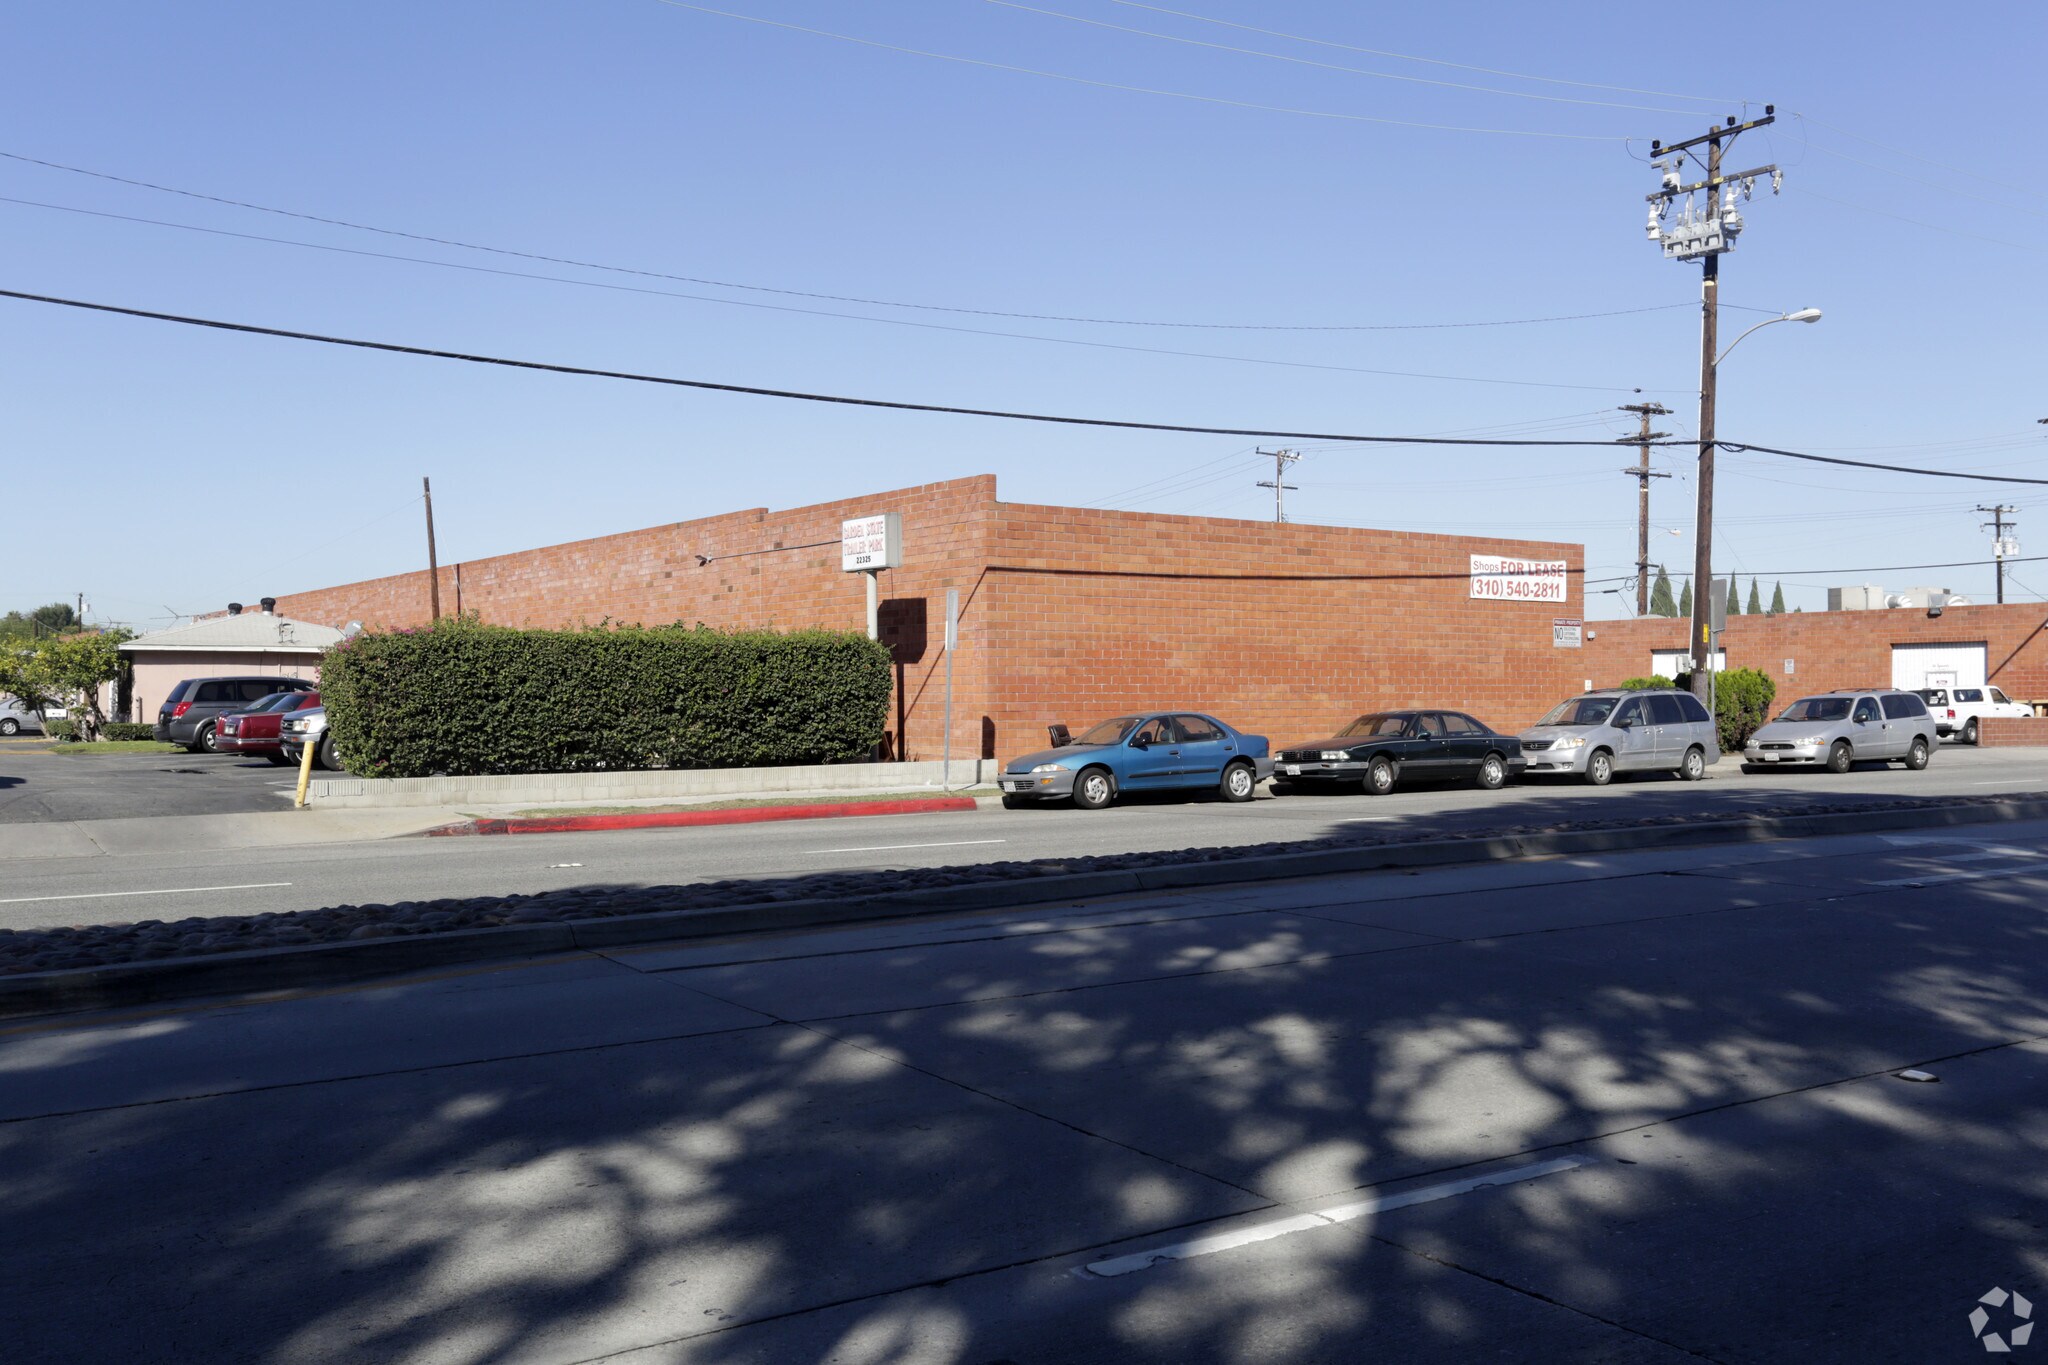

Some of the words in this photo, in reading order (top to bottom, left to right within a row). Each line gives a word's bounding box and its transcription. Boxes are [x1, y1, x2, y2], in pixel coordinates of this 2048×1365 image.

[866, 521, 884, 536] STATE
[844, 541, 866, 556] TRAILER
[869, 538, 884, 552] PARK
[1473, 560, 1499, 572] Shops
[1501, 561, 1524, 575] FOR
[1528, 563, 1564, 577] LEASE
[1471, 577, 1503, 597] (310)
[1506, 580, 1560, 598] 540-2811
[1554, 627, 1563, 640] NO
